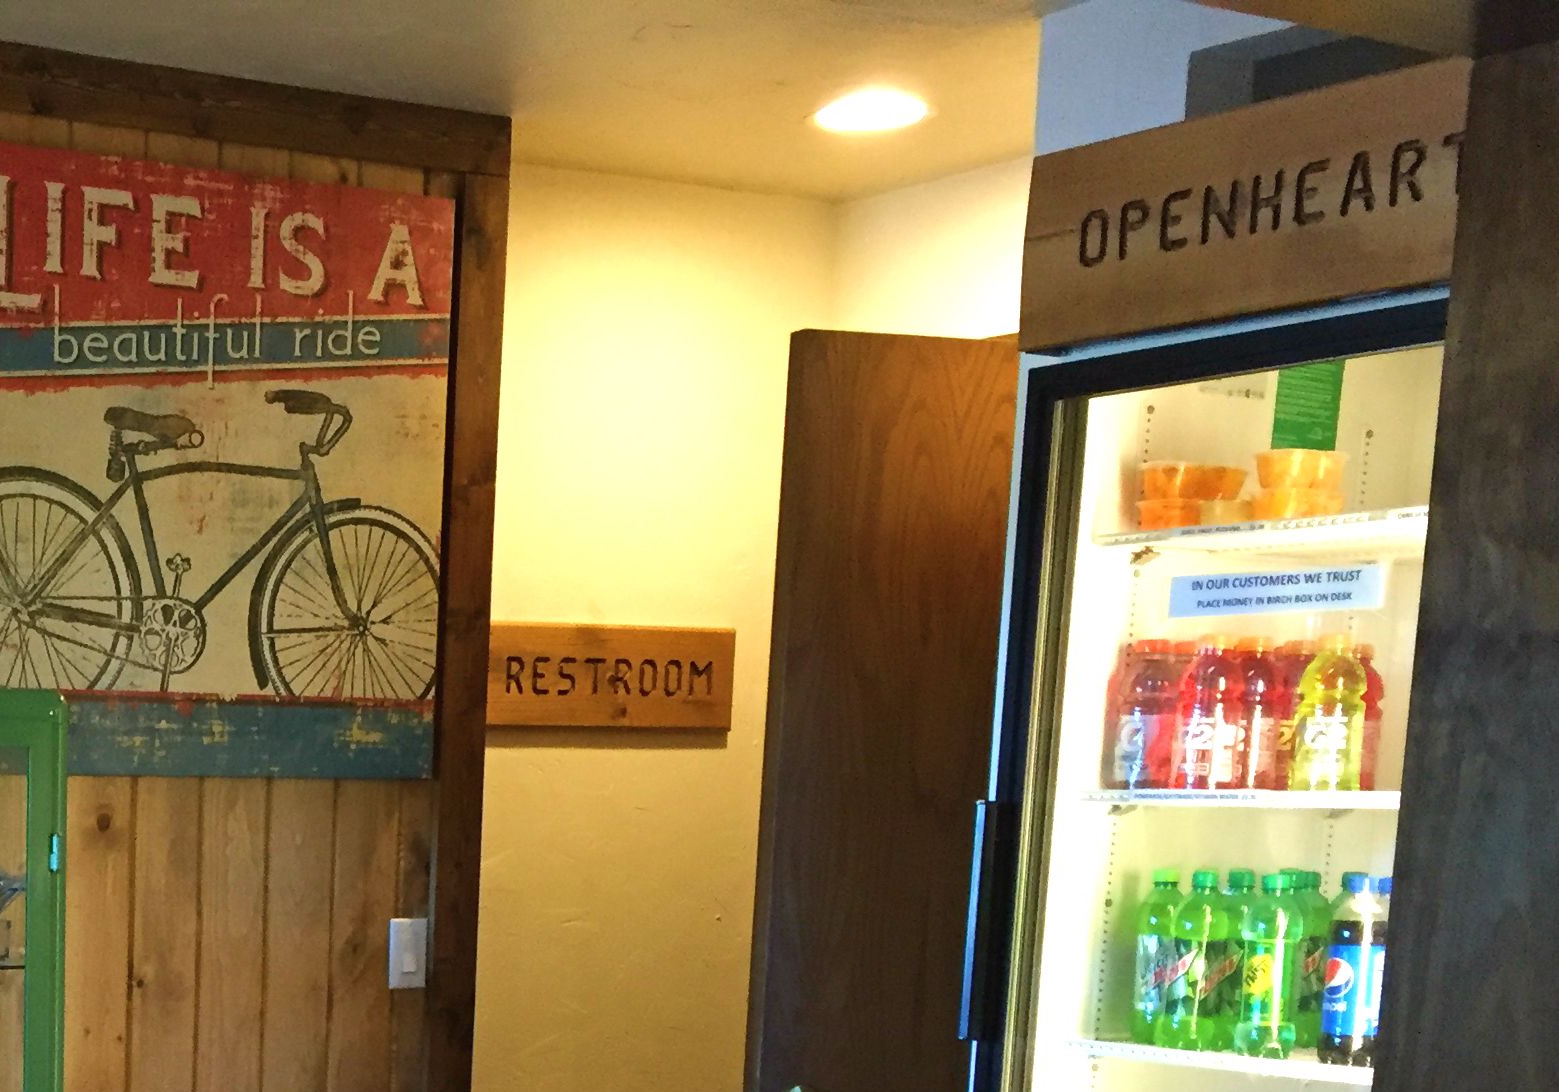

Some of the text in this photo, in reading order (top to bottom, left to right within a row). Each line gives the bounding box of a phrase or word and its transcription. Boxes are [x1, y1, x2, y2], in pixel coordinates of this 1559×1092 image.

[248, 203, 327, 298] IS
[367, 223, 425, 307] A
[52, 284, 382, 389] beautiful ride
[1192, 569, 1362, 591] IN OUR CUSTOMERS WE TRUST
[1294, 594, 1313, 603] BOX
[1315, 593, 1329, 602] ON
[1330, 592, 1352, 601] DESK
[505, 656, 713, 697] RESTROOM
